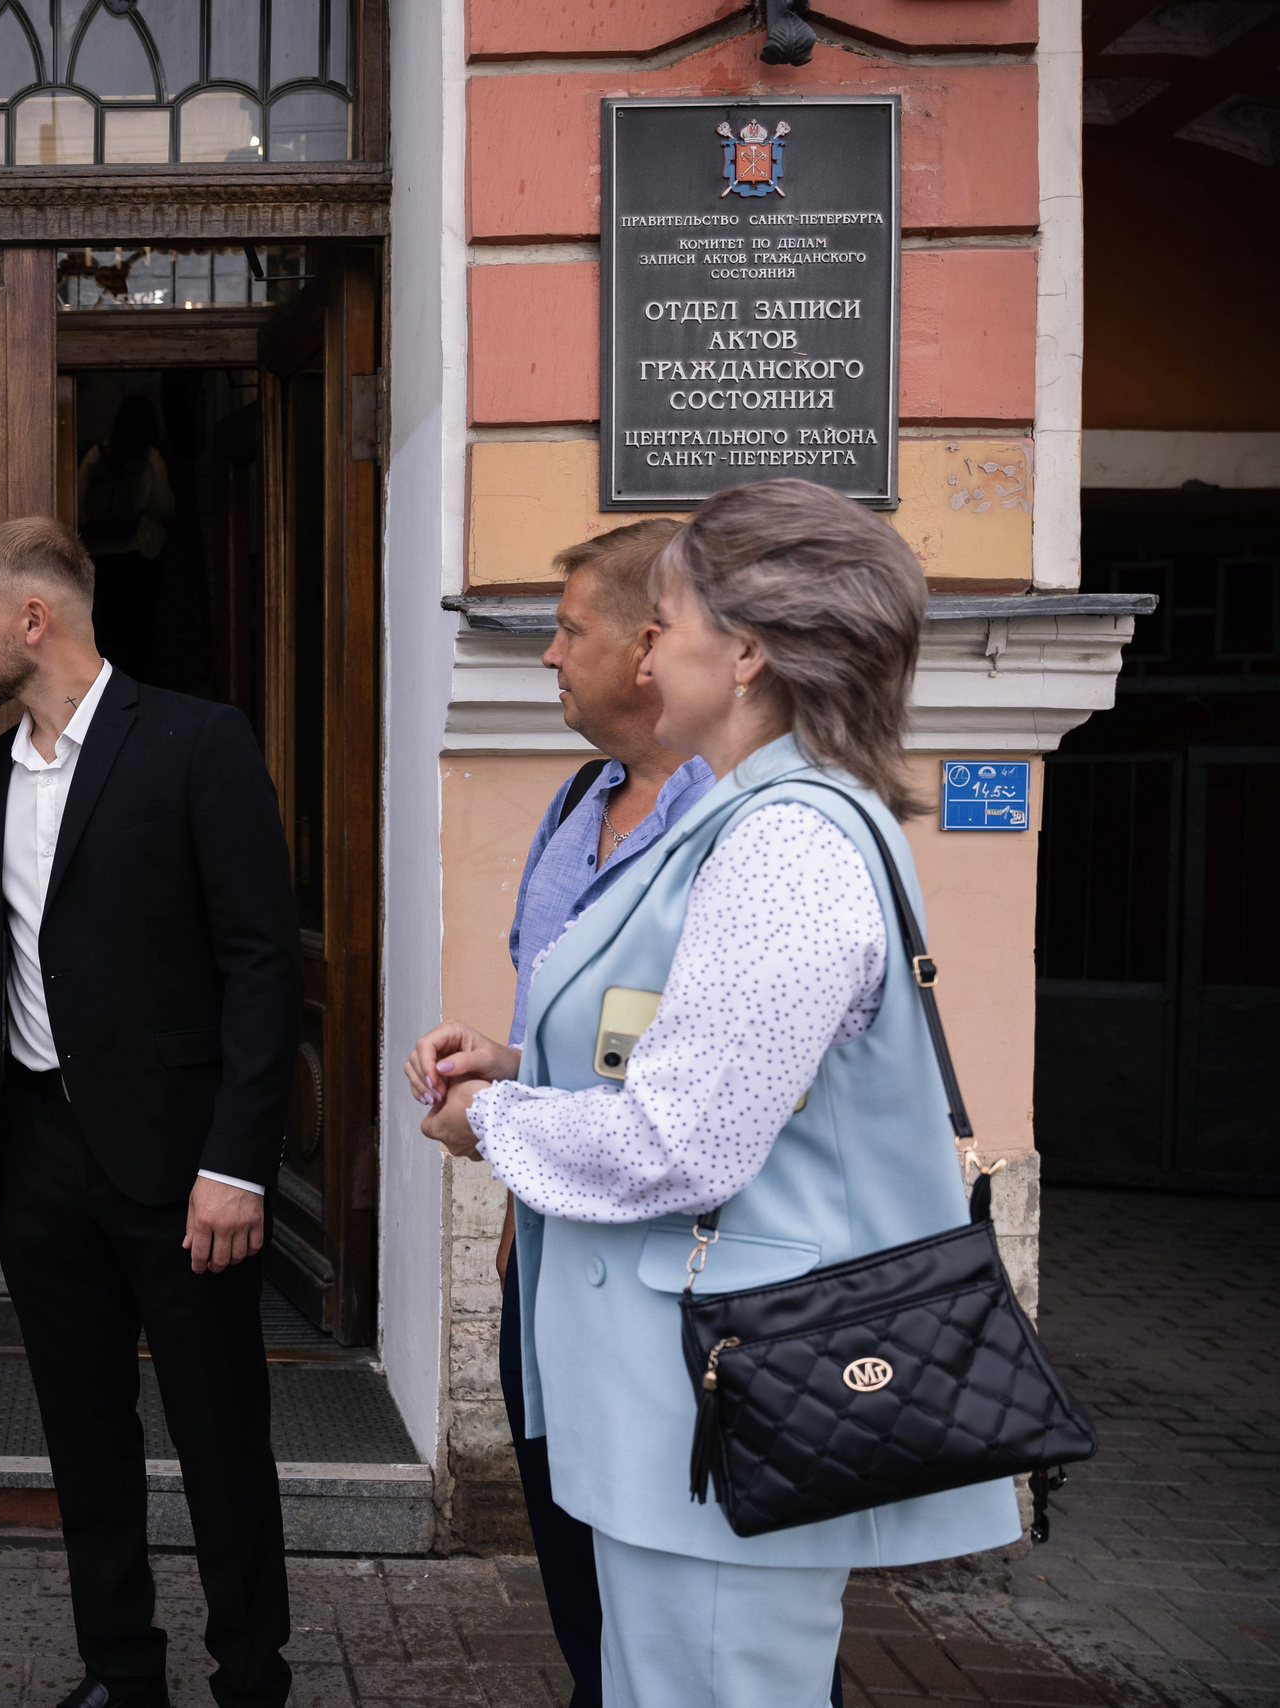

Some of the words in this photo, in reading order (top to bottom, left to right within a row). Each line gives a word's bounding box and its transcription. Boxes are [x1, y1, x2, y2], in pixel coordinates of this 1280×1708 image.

[621, 216, 739, 226] ПРАВИТЕЛЬСТВО
[749, 213, 883, 224] САНКТ-ПЕТЕРБУРГА
[680, 239, 744, 249] КОМИТЕТ
[753, 239, 770, 248] ПО
[777, 238, 826, 249] ДЕЛАМ
[640, 254, 695, 264] ЗАПИСИ
[704, 254, 746, 263] АКТОВ
[755, 252, 866, 264] ГРАЖДАНСКОГО
[711, 268, 795, 278] СОСТОЯНИЯ
[646, 301, 737, 323] ОТДЕЛ
[755, 300, 860, 319] ЗАПИСИ
[709, 330, 797, 349] АКТОВ
[640, 360, 863, 382] ГРАЖДАНСКОГО
[670, 390, 834, 409] СОСТОЯНИЯ
[625, 430, 788, 447] ЦЕНТРАЛЬНОГО
[798, 427, 878, 444] РАЙОНА
[647, 450, 856, 465] САНКТ-ПЕТЕРБУРГА
